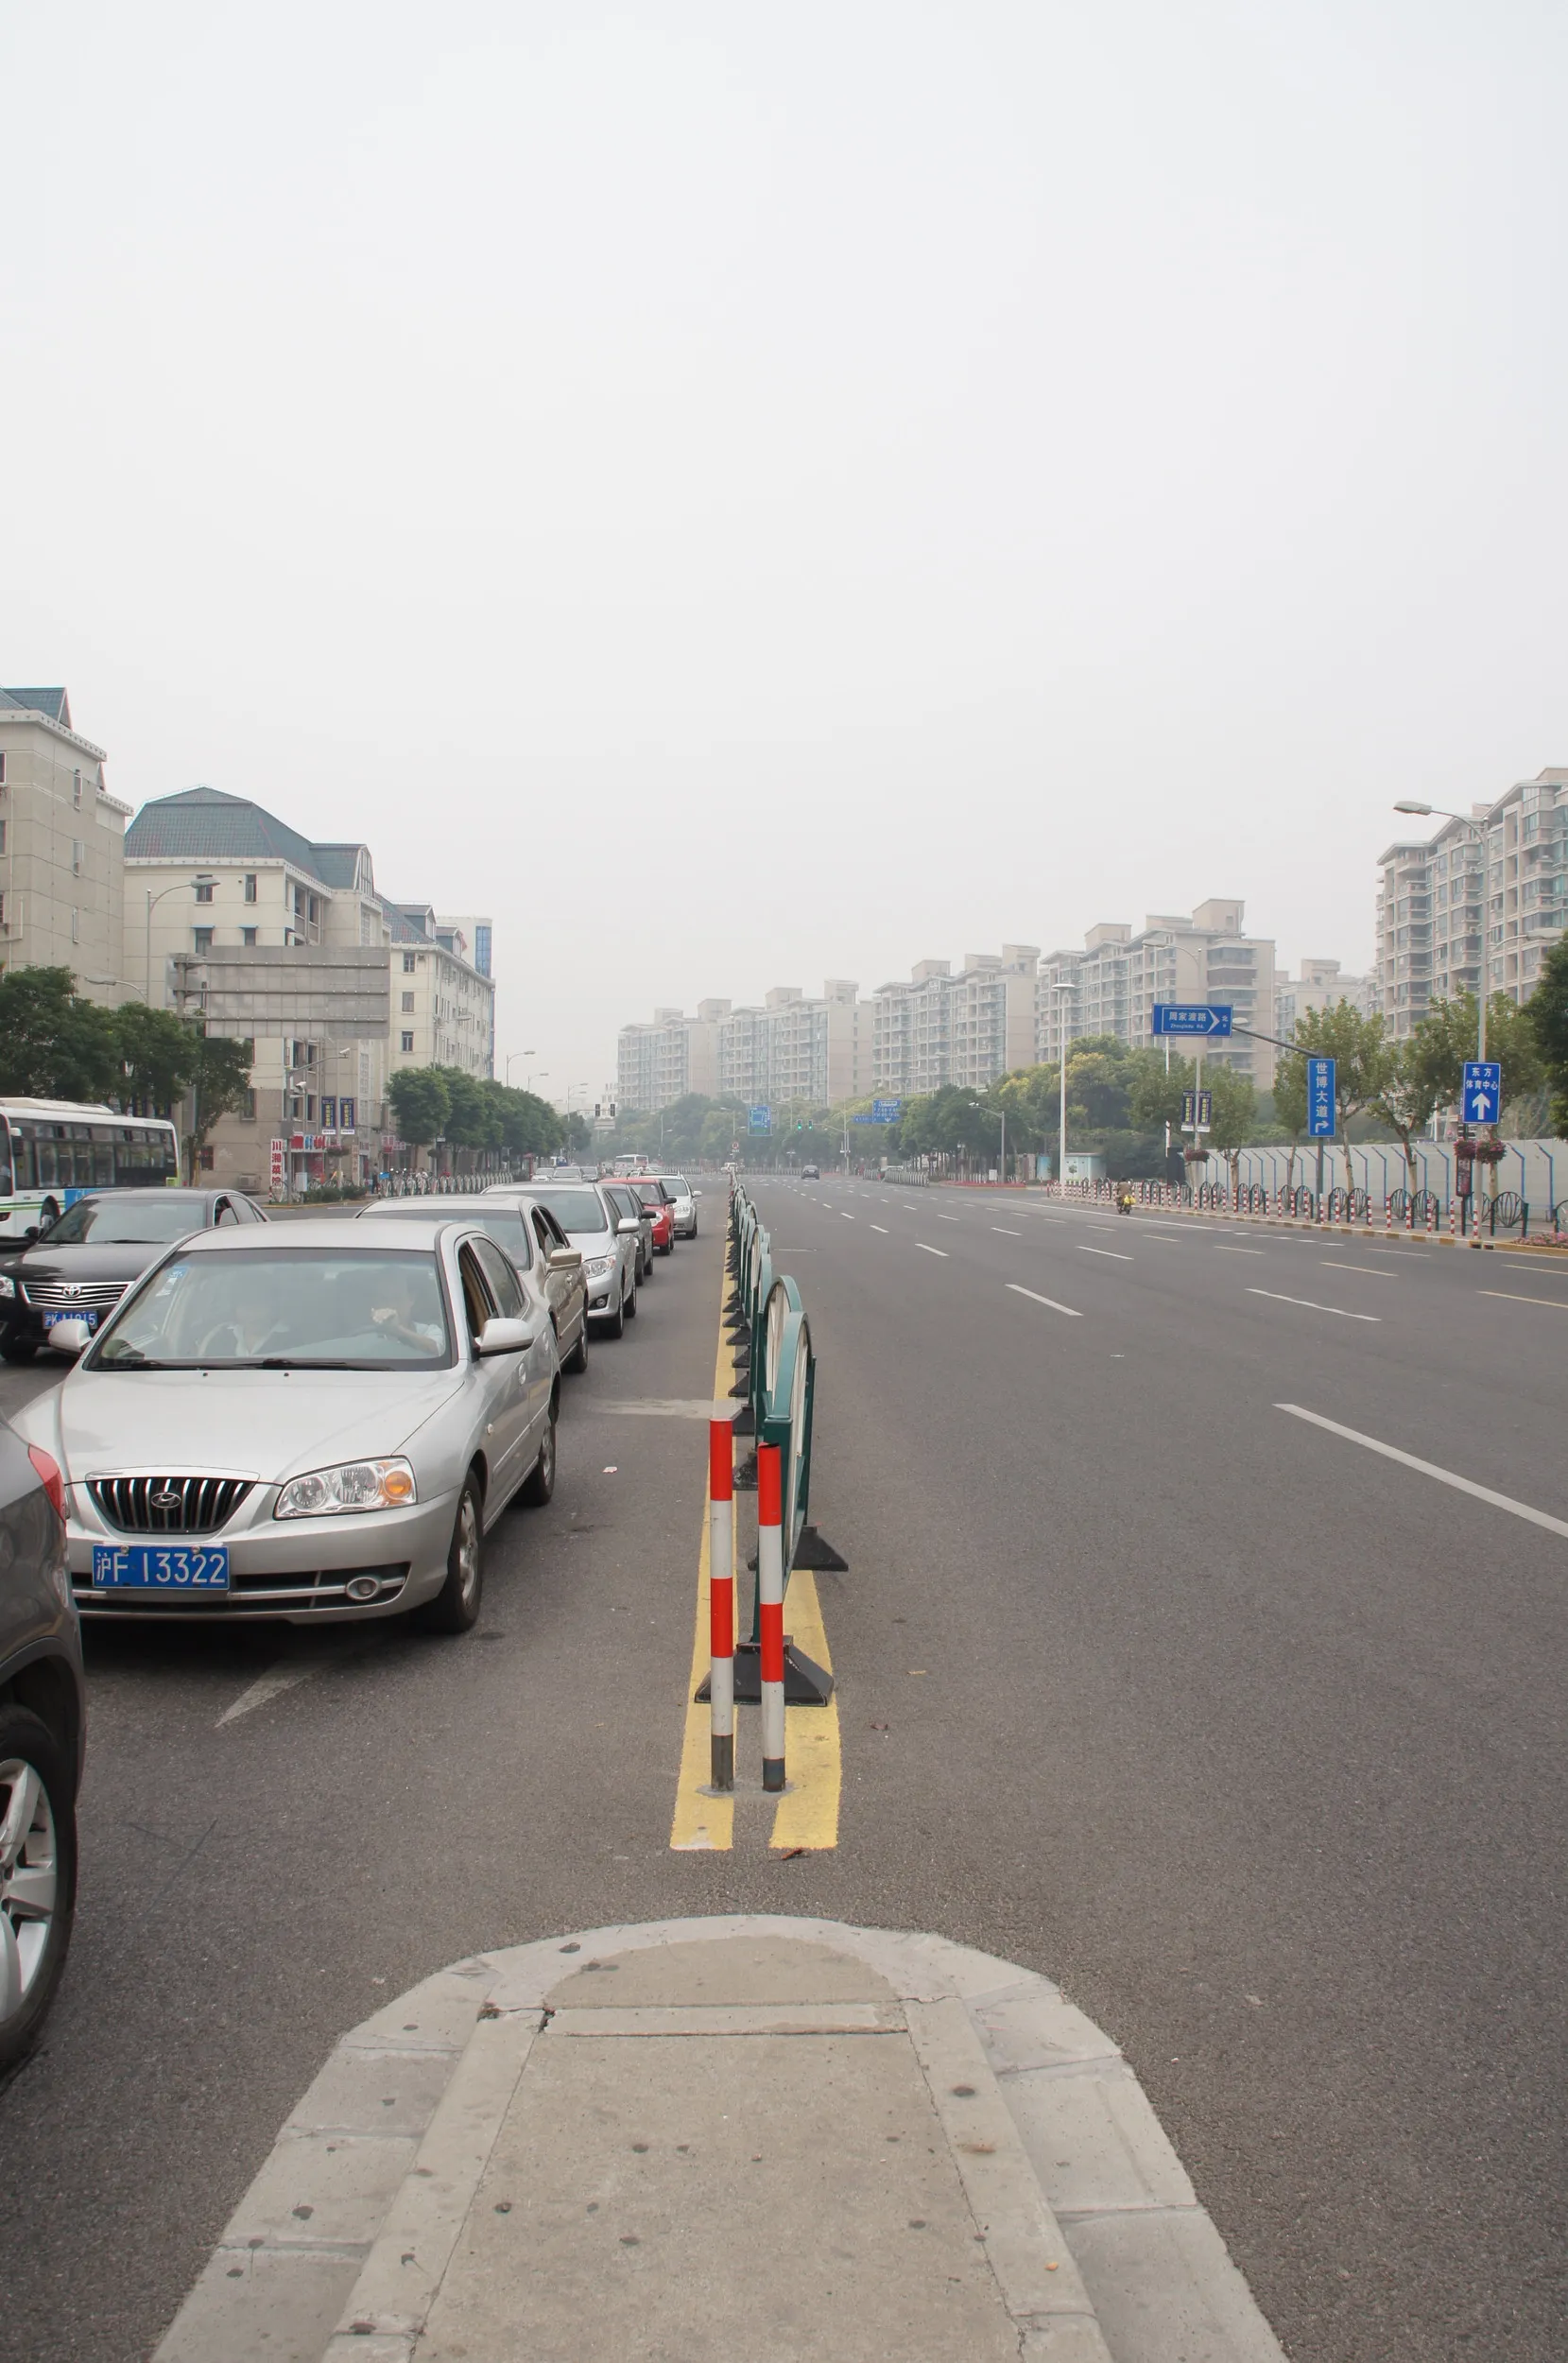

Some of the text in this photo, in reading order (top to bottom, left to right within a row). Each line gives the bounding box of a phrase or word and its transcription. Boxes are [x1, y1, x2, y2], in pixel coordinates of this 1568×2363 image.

[1169, 1011, 1207, 1022] 周家渡路
[1472, 1067, 1492, 1078] 东方
[1316, 1062, 1328, 1117] 世博大道
[1466, 1079, 1498, 1090] 体育中心
[143, 1552, 226, 1583] 13322
